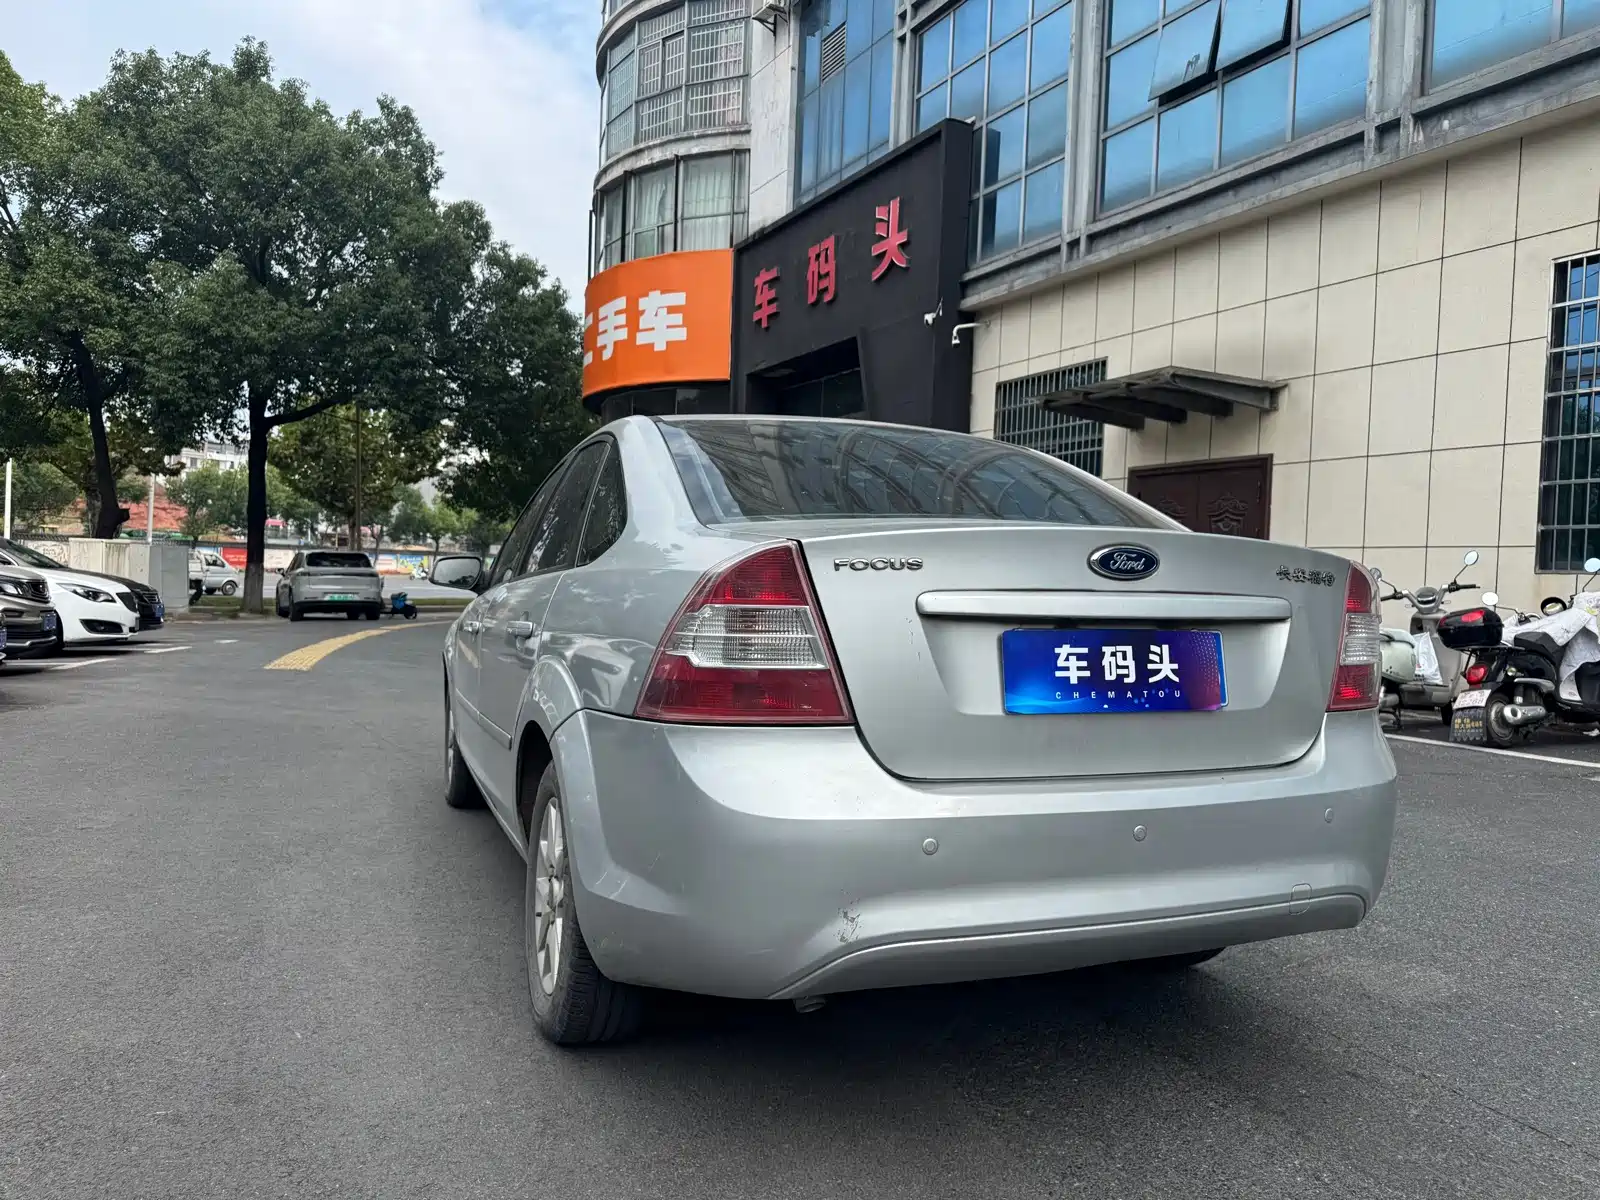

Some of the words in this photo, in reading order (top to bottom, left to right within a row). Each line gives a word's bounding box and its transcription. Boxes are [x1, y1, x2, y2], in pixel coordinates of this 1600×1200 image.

[753, 196, 910, 328] 车码头
[833, 557, 923, 571] FOCUS
[1109, 552, 1146, 570] Ford
[1054, 644, 1180, 684] 车码头
[1055, 690, 1181, 699] CHEMATOU
